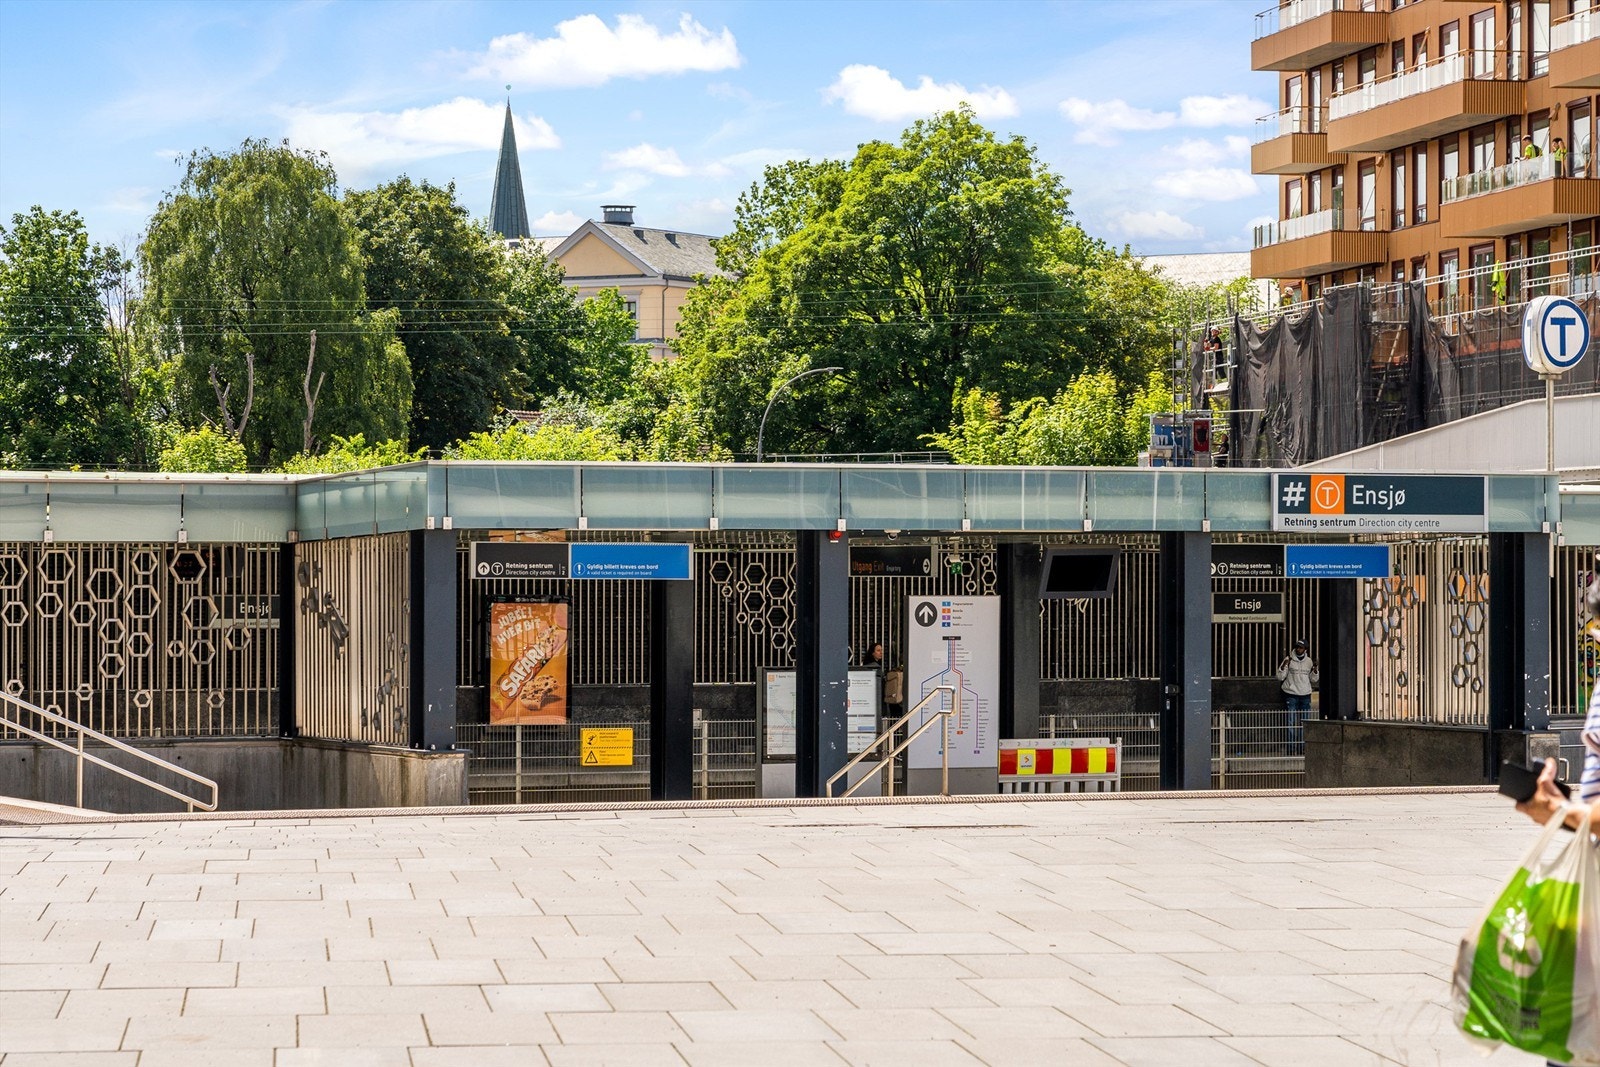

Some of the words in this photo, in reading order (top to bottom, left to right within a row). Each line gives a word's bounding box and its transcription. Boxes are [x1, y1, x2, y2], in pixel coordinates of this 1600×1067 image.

[1550, 317, 1576, 356] T
[1352, 484, 1406, 510] Ensjø
[1284, 517, 1318, 529] Retning
[1319, 518, 1357, 528] sentrum
[1359, 517, 1396, 528] Direction
[1397, 517, 1413, 529] city
[1414, 518, 1440, 528] centre
[530, 569, 539, 578] city
[586, 562, 603, 571] Gyldig
[604, 562, 620, 570] billett
[620, 562, 637, 570] kreves
[646, 562, 659, 570] bord
[852, 560, 873, 574] Utgang
[1250, 569, 1258, 577] city
[1299, 562, 1314, 571] Gyldig
[1314, 562, 1328, 570] billett
[239, 602, 272, 616] Ensjø
[1234, 598, 1262, 612] Ensjø
[497, 607, 527, 630] JUBEL
[496, 623, 523, 645] HVER
[523, 618, 541, 632] BIT
[501, 643, 546, 698] SAFARI
